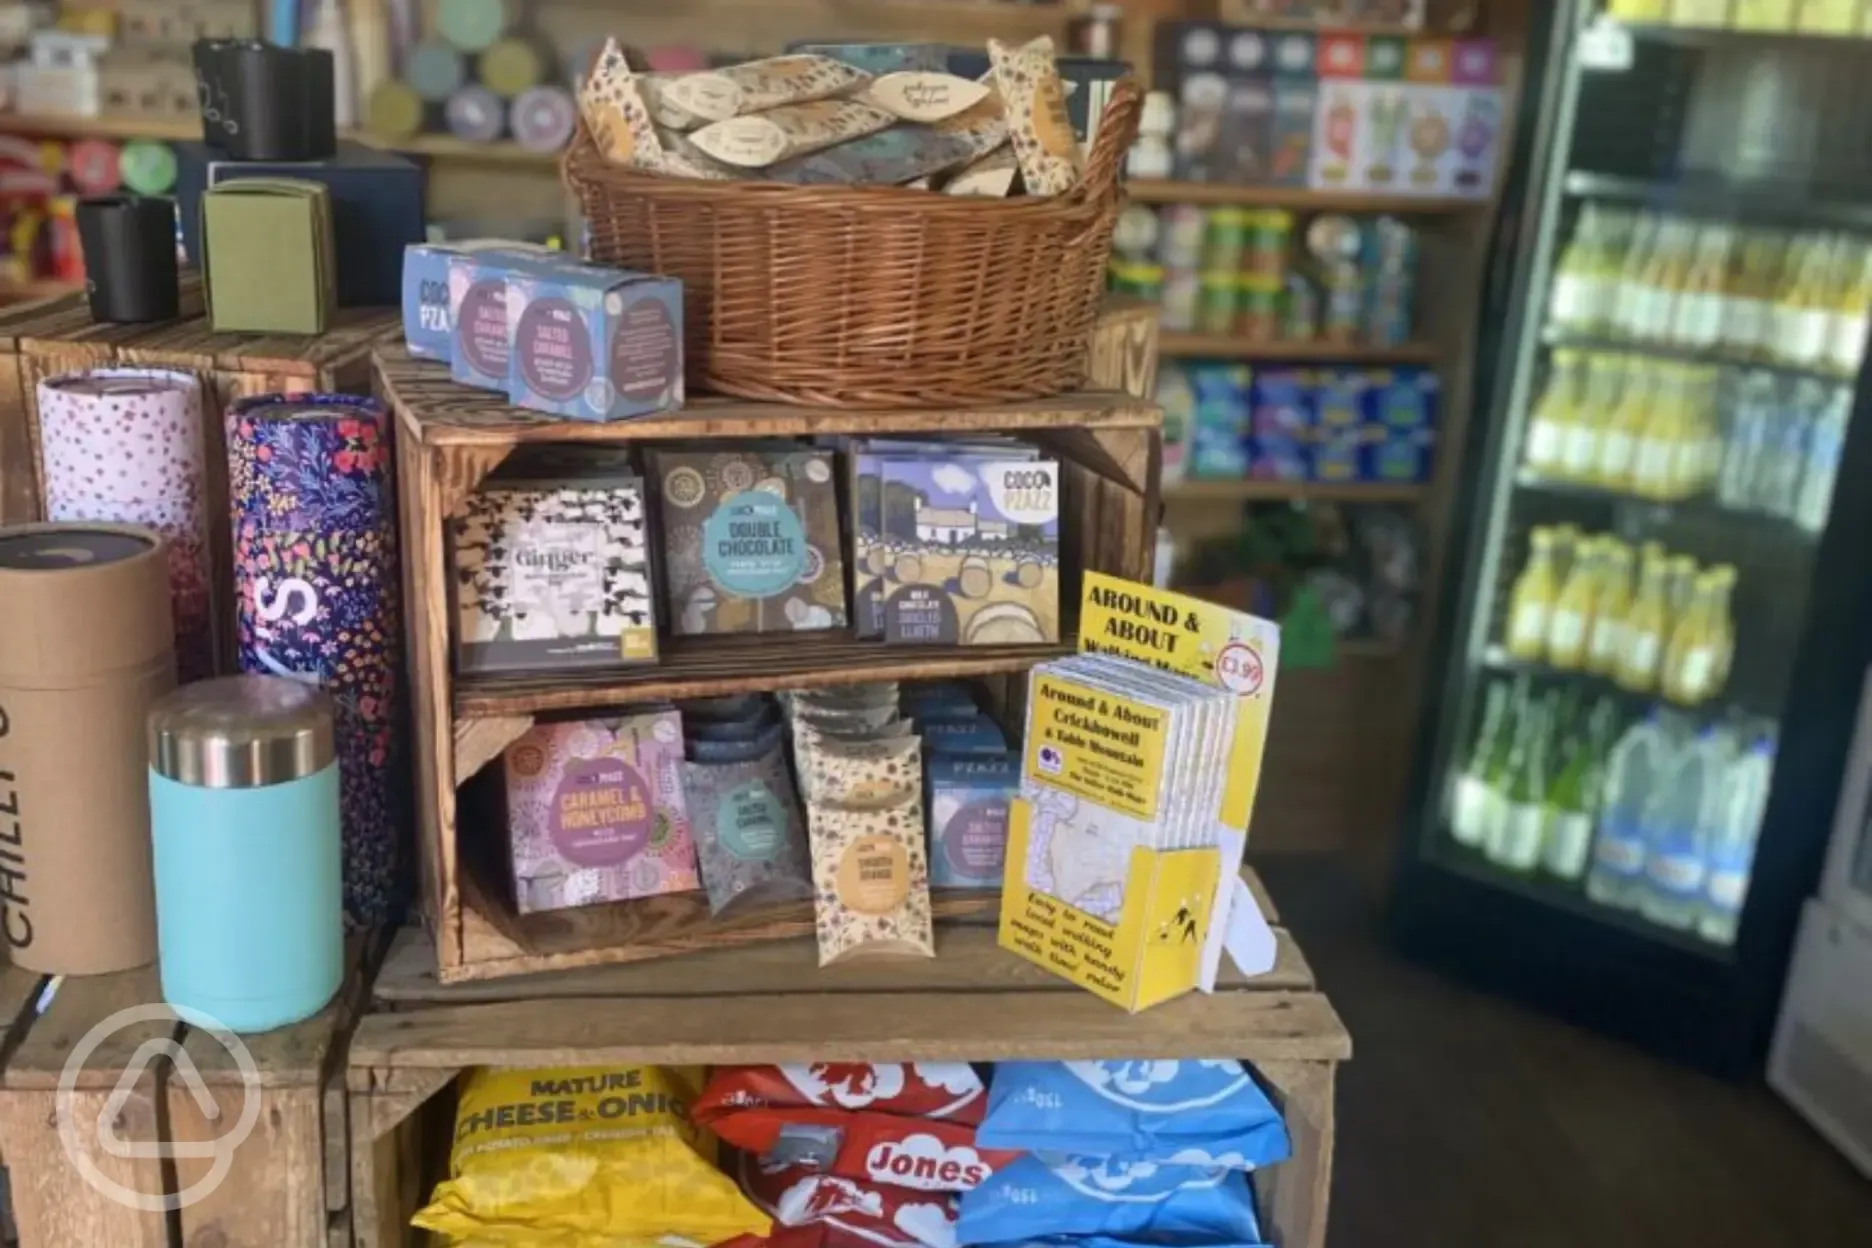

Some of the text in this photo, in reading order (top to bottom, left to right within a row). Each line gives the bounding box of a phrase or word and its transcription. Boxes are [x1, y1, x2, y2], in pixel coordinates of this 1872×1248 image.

[420, 278, 449, 305] COC
[728, 521, 781, 538] DOUBLE
[516, 549, 594, 571] Ginger
[718, 537, 796, 558] CHOCOLATE
[1089, 585, 1200, 633] AROUND &
[1104, 617, 1179, 653] ABOUT
[1040, 683, 1096, 711] Around
[1113, 705, 1159, 732] About
[1053, 708, 1140, 748] Crickhowell
[560, 788, 624, 811] CARAMEL
[560, 803, 647, 830] HONEYCOMB
[530, 1069, 642, 1097] MATURE
[457, 1100, 576, 1141] CHEESE
[870, 1146, 986, 1186] Jones
